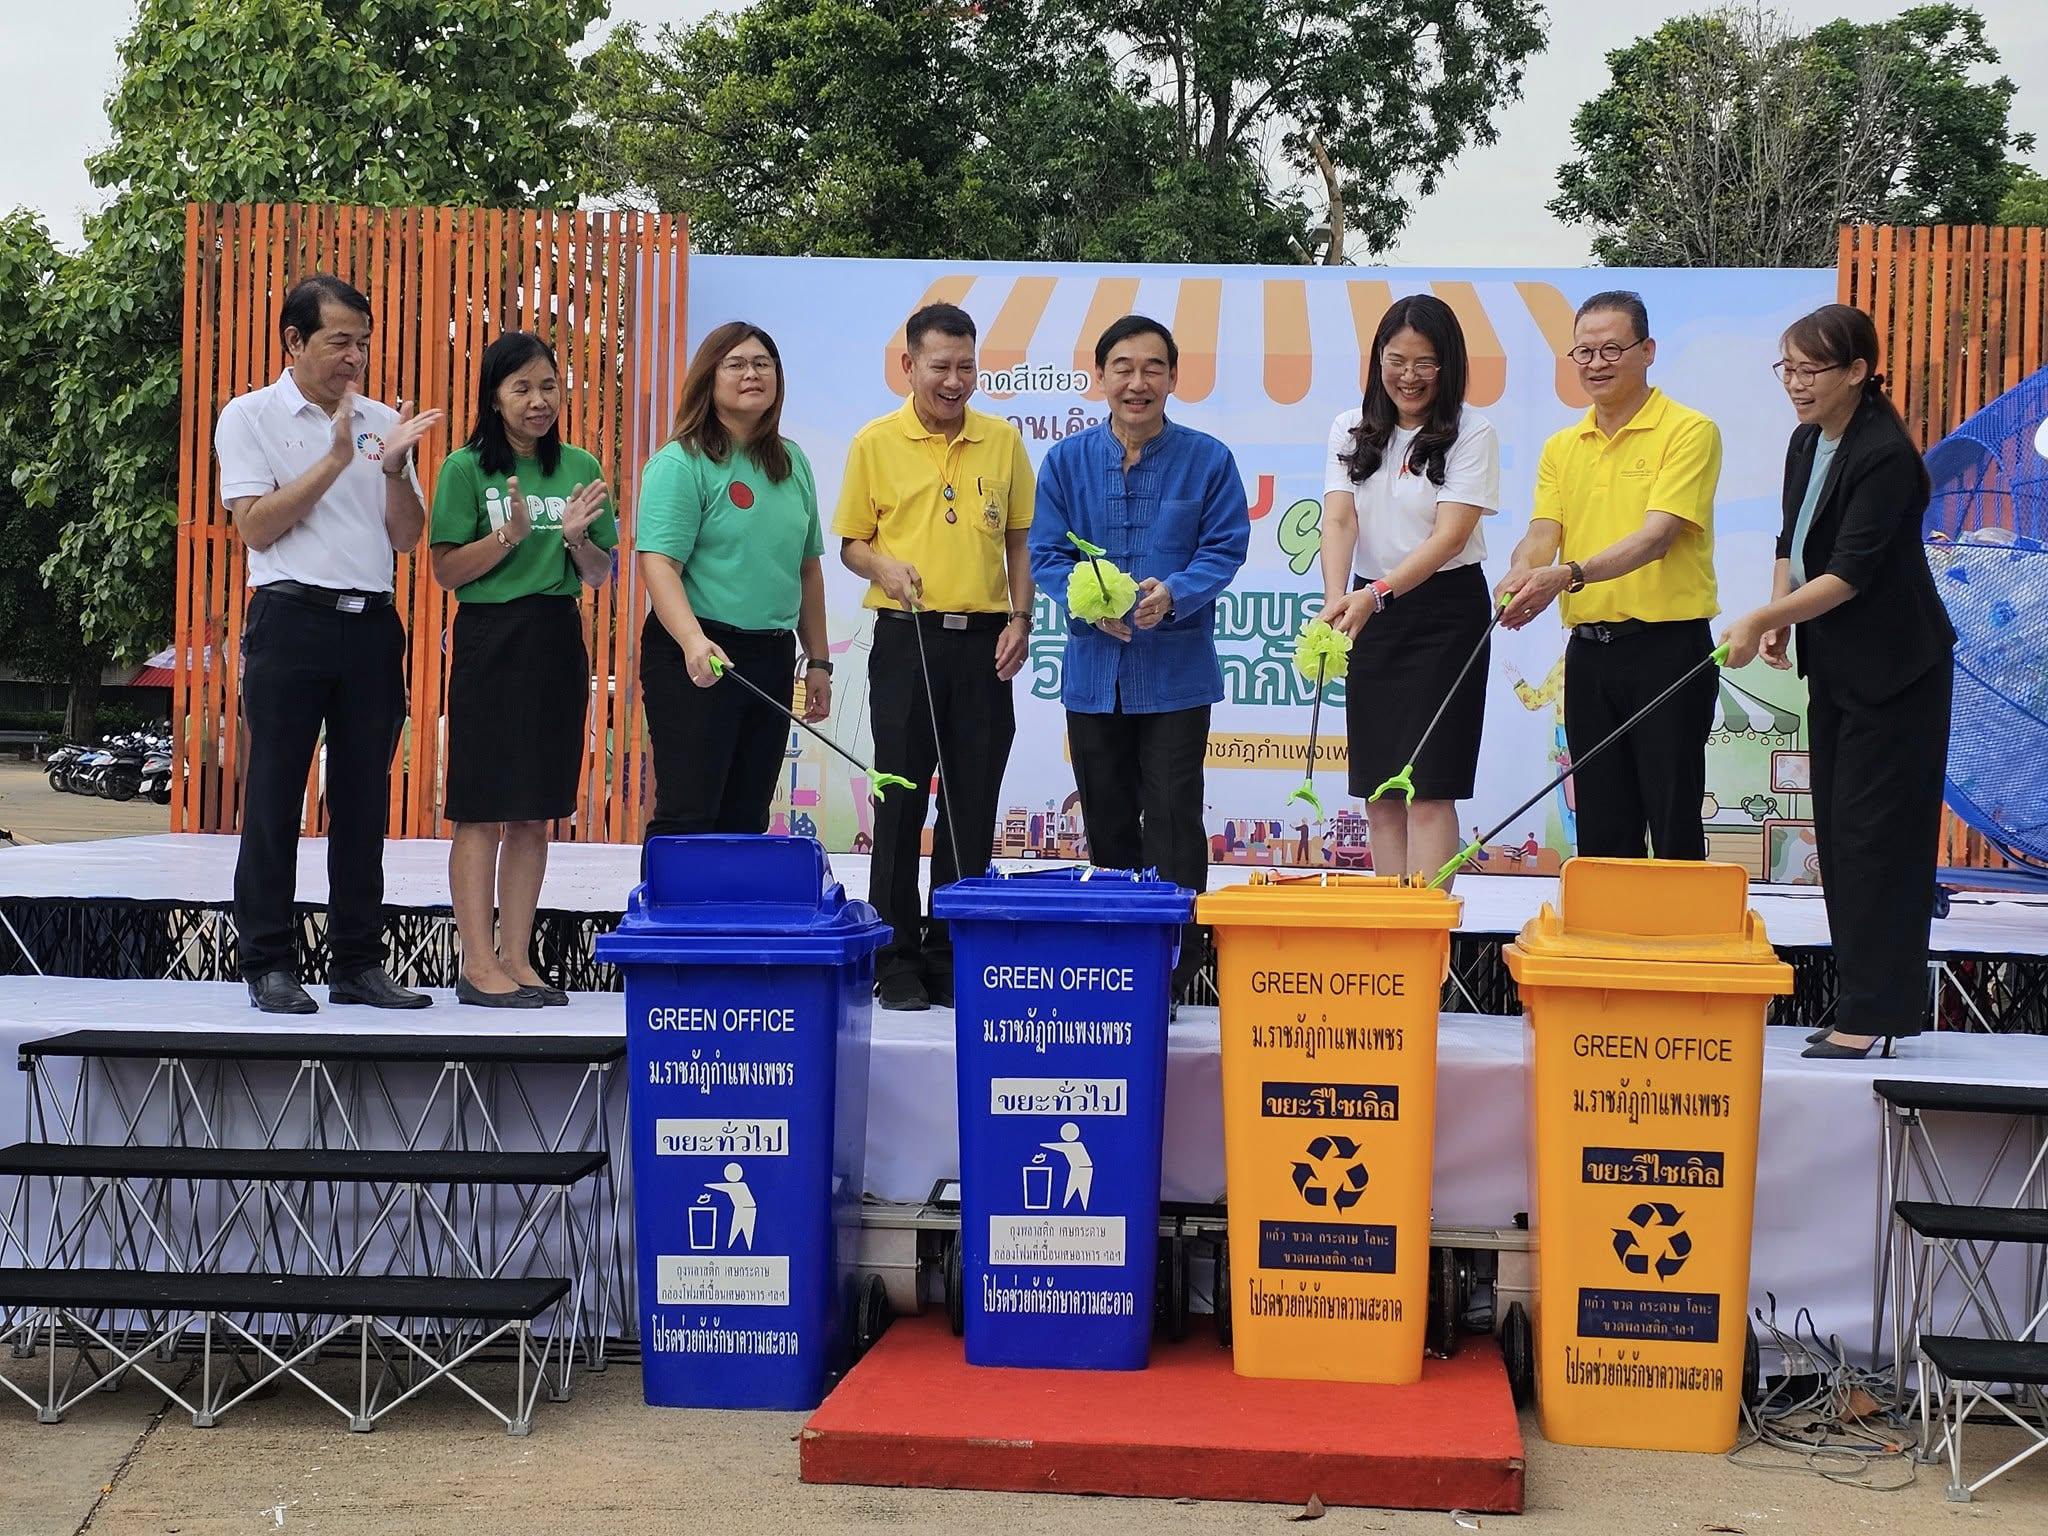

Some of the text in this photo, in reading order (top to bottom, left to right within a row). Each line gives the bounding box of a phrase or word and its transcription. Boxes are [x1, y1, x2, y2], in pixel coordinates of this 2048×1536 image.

[979, 364, 1089, 392] าดสีเขียว
[983, 965, 1134, 991] GREEN OFFICE
[1252, 971, 1405, 996] GREEN OFFICE
[648, 1007, 795, 1032] GREEN OFFICE
[1573, 1034, 1733, 1062] GREEN OFFICE
[997, 1080, 1122, 1112] ขยะทั่วไป
[1266, 1086, 1396, 1119] ขยะรีไซเคิล
[662, 1120, 783, 1152] ขยะทั่วไป
[1586, 1152, 1720, 1186] ขยะรีไซเคิล
[982, 1273, 1134, 1316] โปรดช่วยกันรักษาความสะอาด
[1249, 1277, 1403, 1322] โปรดช่วยกันรักษาความสะอาด
[652, 1313, 799, 1356] โปรดช่วยกันรักษาความสะอาด
[1565, 1345, 1724, 1392] โปรดช่วยกันรักษาความสะอาด
